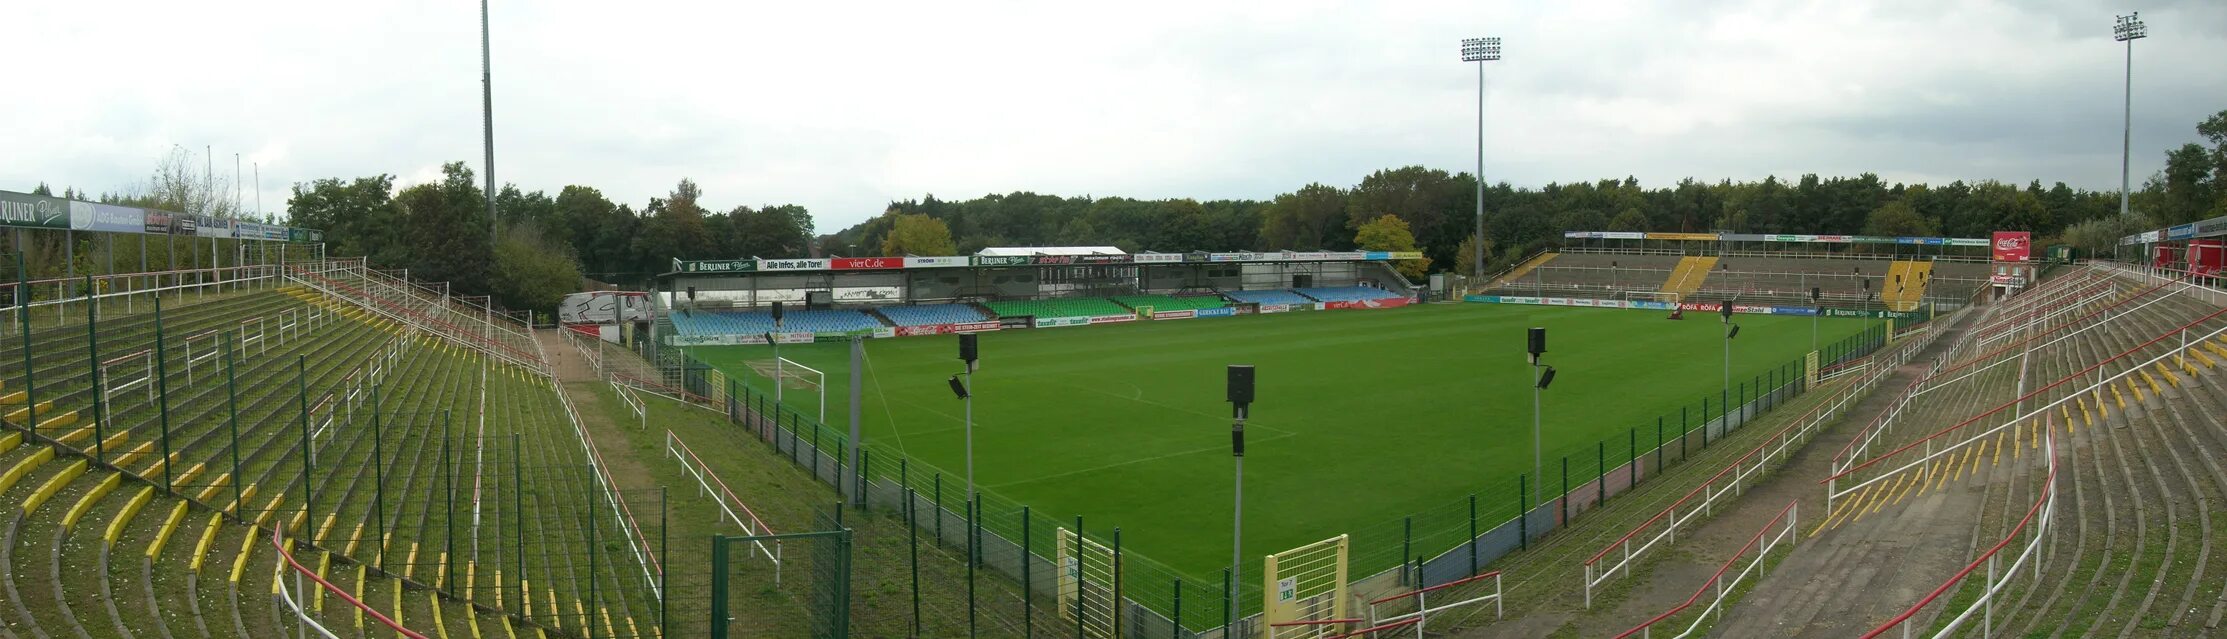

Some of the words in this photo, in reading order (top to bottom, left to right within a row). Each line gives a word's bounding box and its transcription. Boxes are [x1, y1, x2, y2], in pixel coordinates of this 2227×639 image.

[767, 260, 778, 269] Alle
[779, 260, 795, 269] Infos,
[796, 260, 807, 269] alle
[808, 259, 822, 268] Tore!
[981, 256, 1007, 265] BERLINER
[700, 261, 730, 271] BERLINER
[1682, 302, 1697, 311] RÖFA
[1700, 303, 1716, 311] RÖFA
